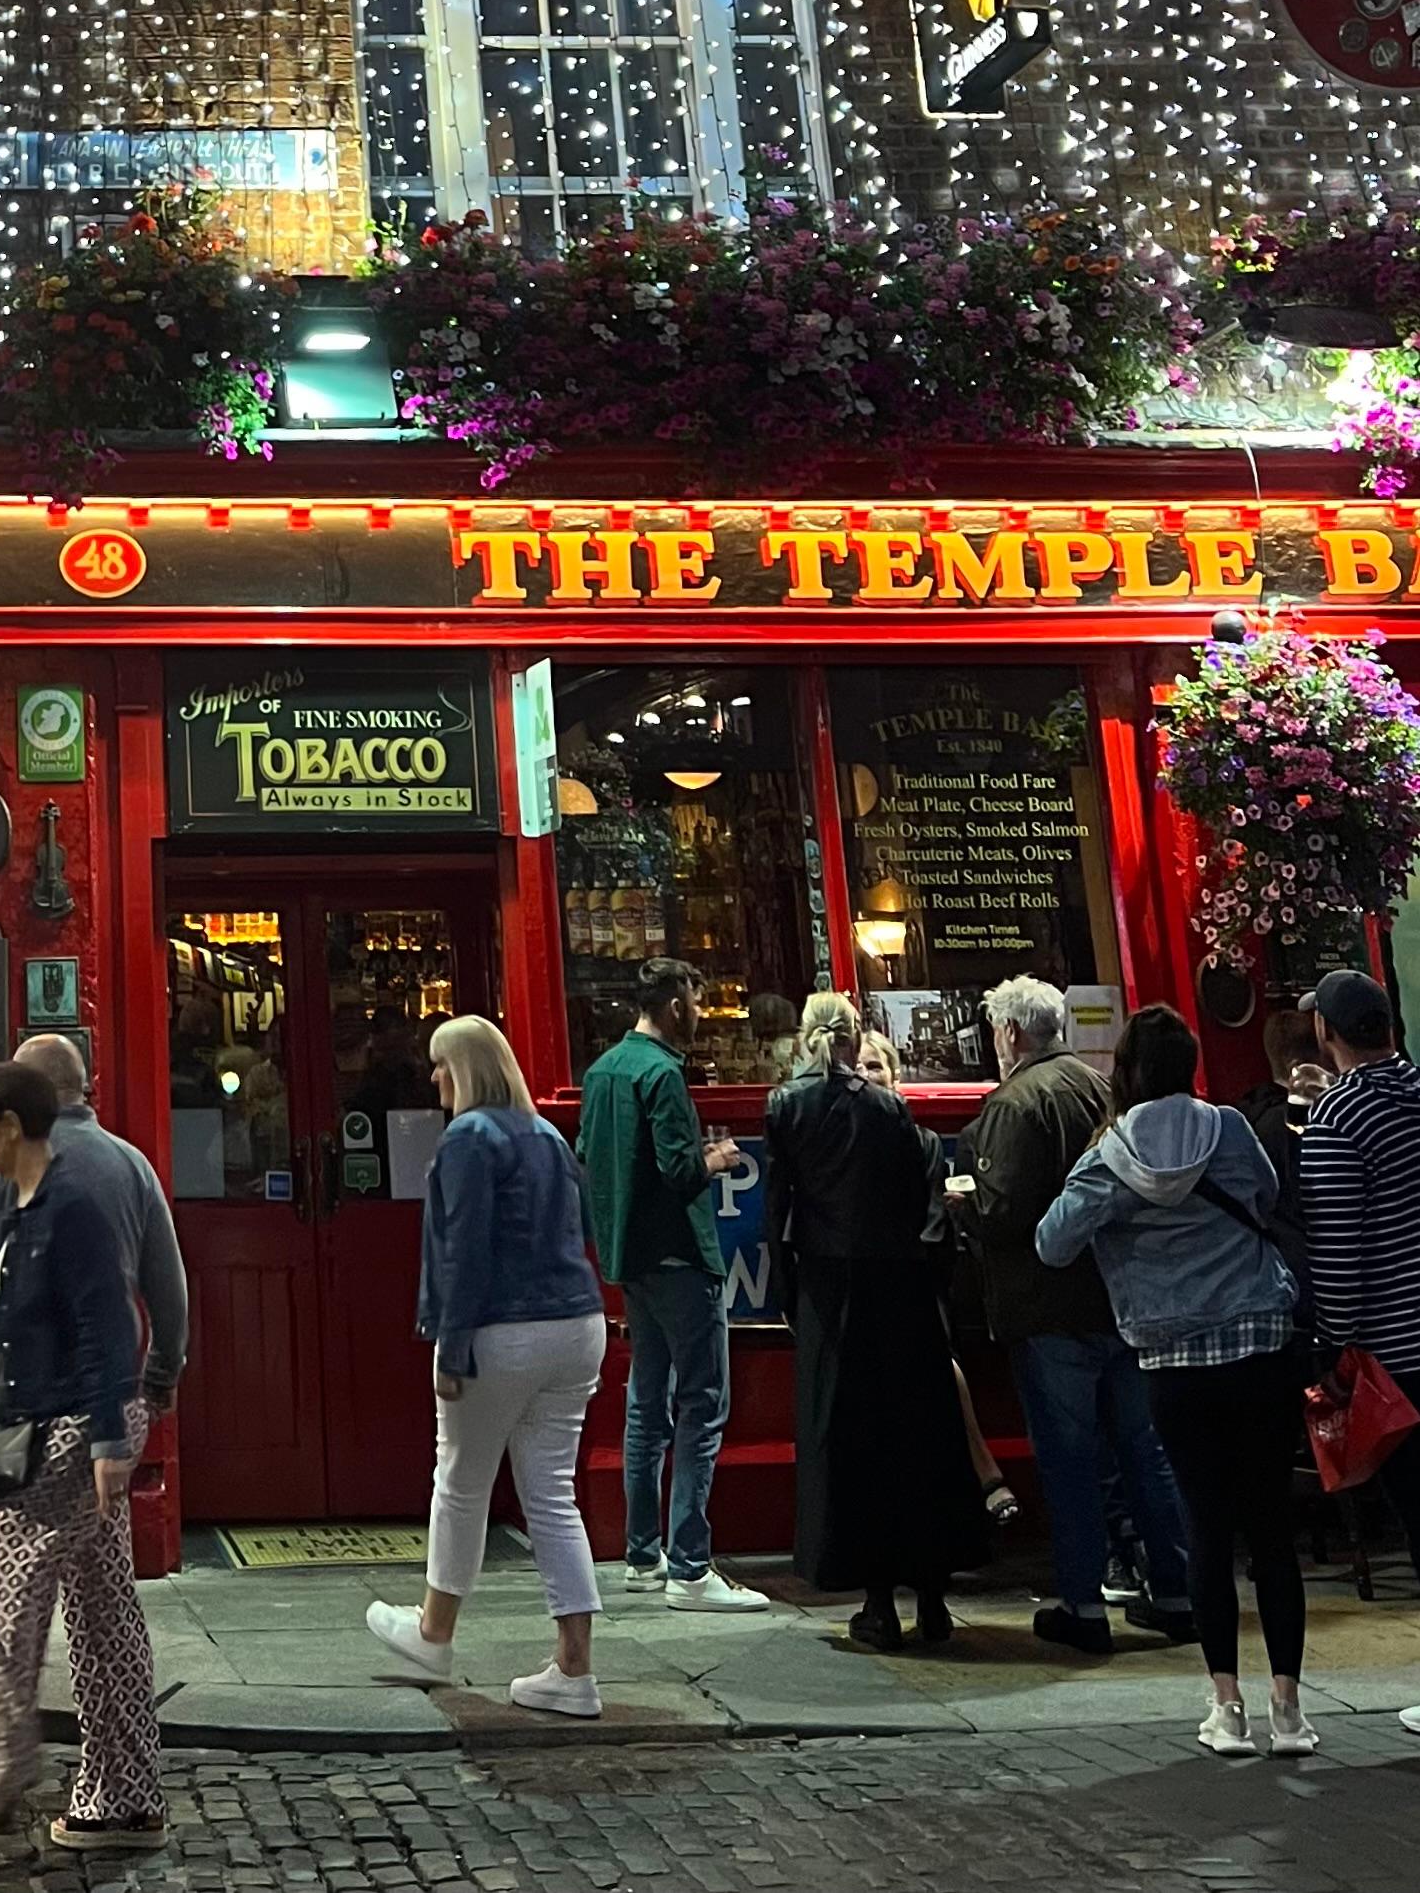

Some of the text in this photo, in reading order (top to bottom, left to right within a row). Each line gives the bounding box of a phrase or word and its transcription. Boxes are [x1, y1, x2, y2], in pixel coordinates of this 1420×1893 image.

[74, 539, 128, 582] 48
[456, 529, 1420, 602] THE TEMPLE B
[180, 666, 306, 722] Importers
[259, 699, 282, 714] OF
[293, 709, 442, 729] FINE SMOKING
[870, 707, 994, 743] TEMPLE
[968, 737, 1003, 754] 1840
[32, 750, 71, 761] Official
[215, 721, 448, 803] TOBACCO
[30, 760, 75, 773] Member
[893, 773, 1057, 791] Traditional Food Fare
[265, 788, 470, 810] Always in Stock
[880, 796, 1075, 815] Meat Plate, Cheese Board
[854, 821, 1090, 843] Fresh Oysters, Smoked Salmon
[876, 844, 1073, 863] Charcuterie Meats, Olives
[901, 868, 1054, 886] Toasted Sandwiches
[899, 892, 1061, 909] Hot Roast Beef Rolls
[945, 924, 1021, 936] Kitchen Times
[978, 937, 991, 949] to
